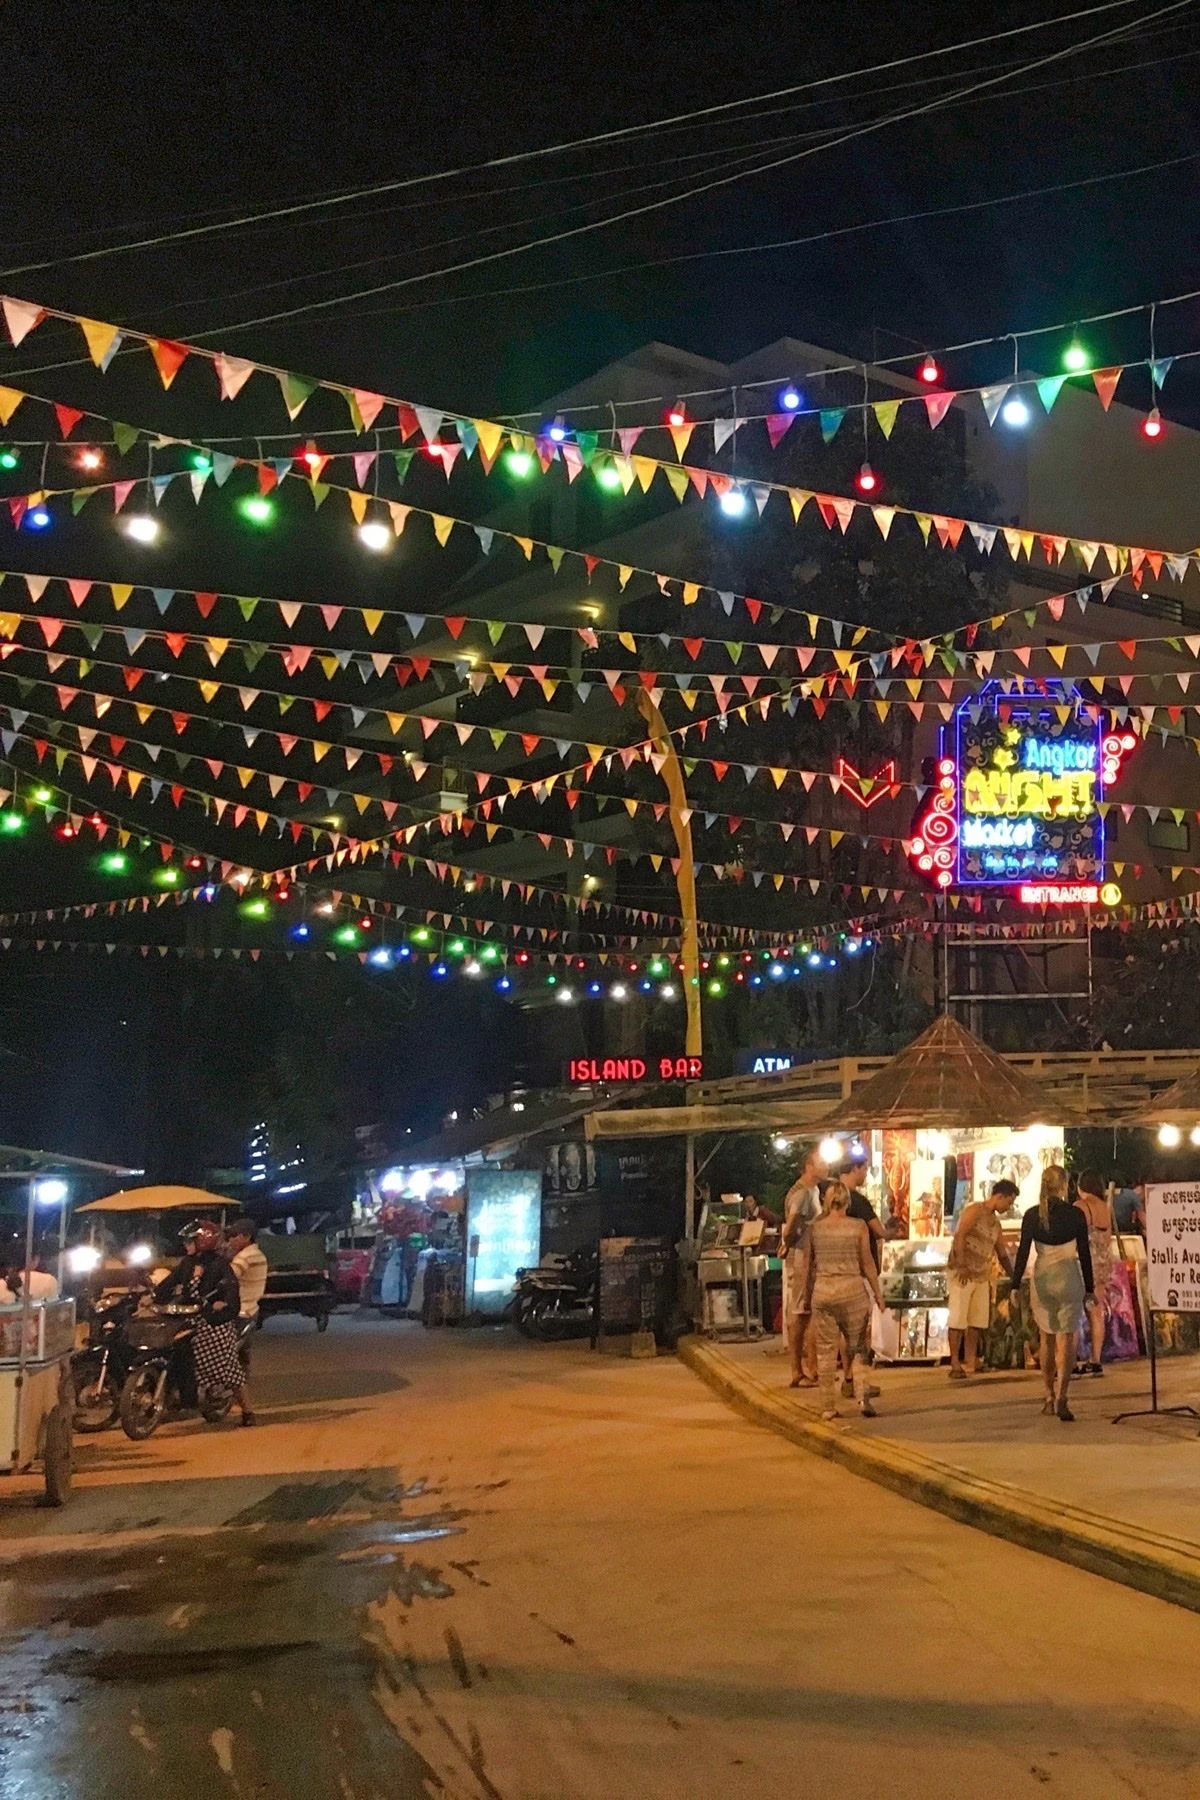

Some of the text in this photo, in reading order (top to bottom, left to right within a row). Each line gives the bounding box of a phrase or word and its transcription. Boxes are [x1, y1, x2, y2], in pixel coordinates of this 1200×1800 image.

[1026, 739, 1096, 773] Angkor
[1021, 886, 1098, 903] ENTRANCE
[569, 1058, 702, 1081] ISLAND BAR
[753, 1057, 791, 1074] ATM
[1152, 1247, 1178, 1265] Stalls
[1170, 1268, 1186, 1284] For
